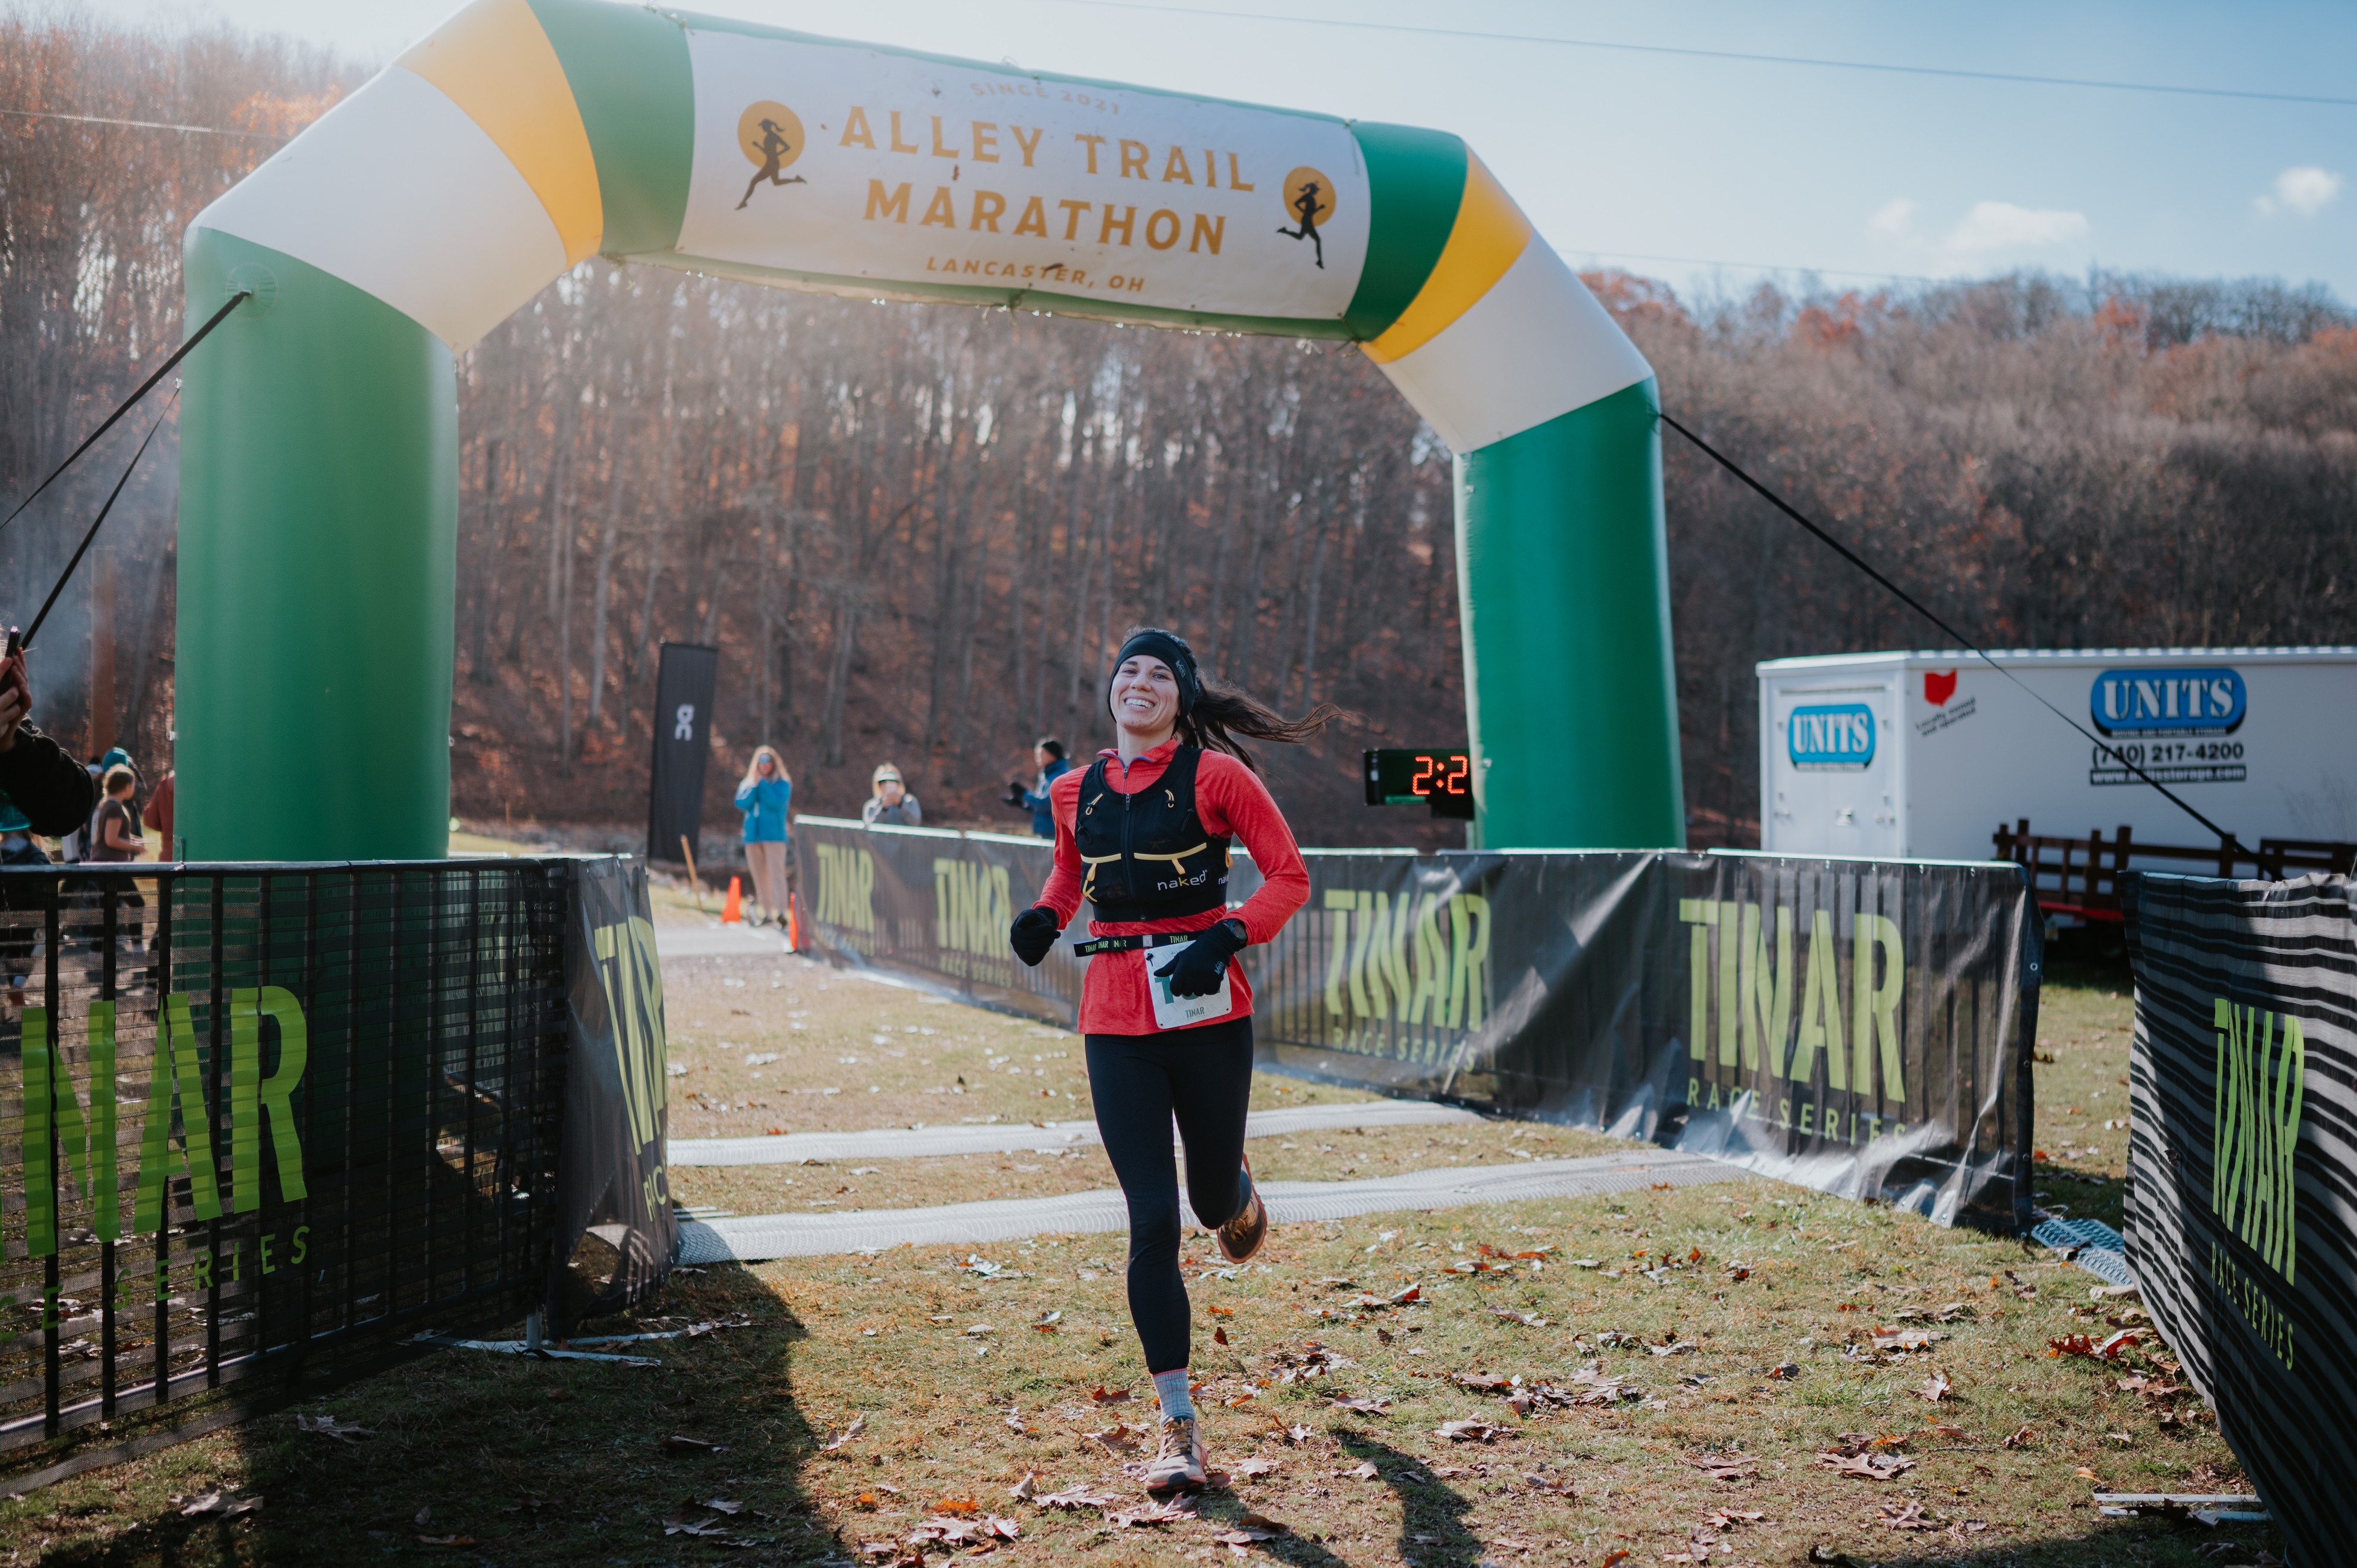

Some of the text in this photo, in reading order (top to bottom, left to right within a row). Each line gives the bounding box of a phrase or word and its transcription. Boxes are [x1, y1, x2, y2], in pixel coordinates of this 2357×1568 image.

[970, 82, 1120, 115] SINCE 2021
[838, 106, 1255, 193] ALLEY TRAIL
[863, 179, 1227, 255] MARATHON
[926, 257, 1145, 292] LANCASTER, OH
[1792, 712, 1870, 754] UNITS
[2103, 678, 2233, 719] UNITS
[2152, 742, 2244, 762] 217-4200
[816, 843, 874, 933] TINAR
[934, 857, 1011, 962] TINAR
[1324, 889, 1492, 1032] TINAR
[1679, 898, 1905, 1103] TINAR
[1185, 1006, 1204, 1018] TINAR
[1332, 1027, 1387, 1057] RACE
[2213, 998, 2304, 1286] TINAR
[111, 1226, 310, 1310] SERIES
[2211, 1241, 2294, 1370] RACE SERIES
